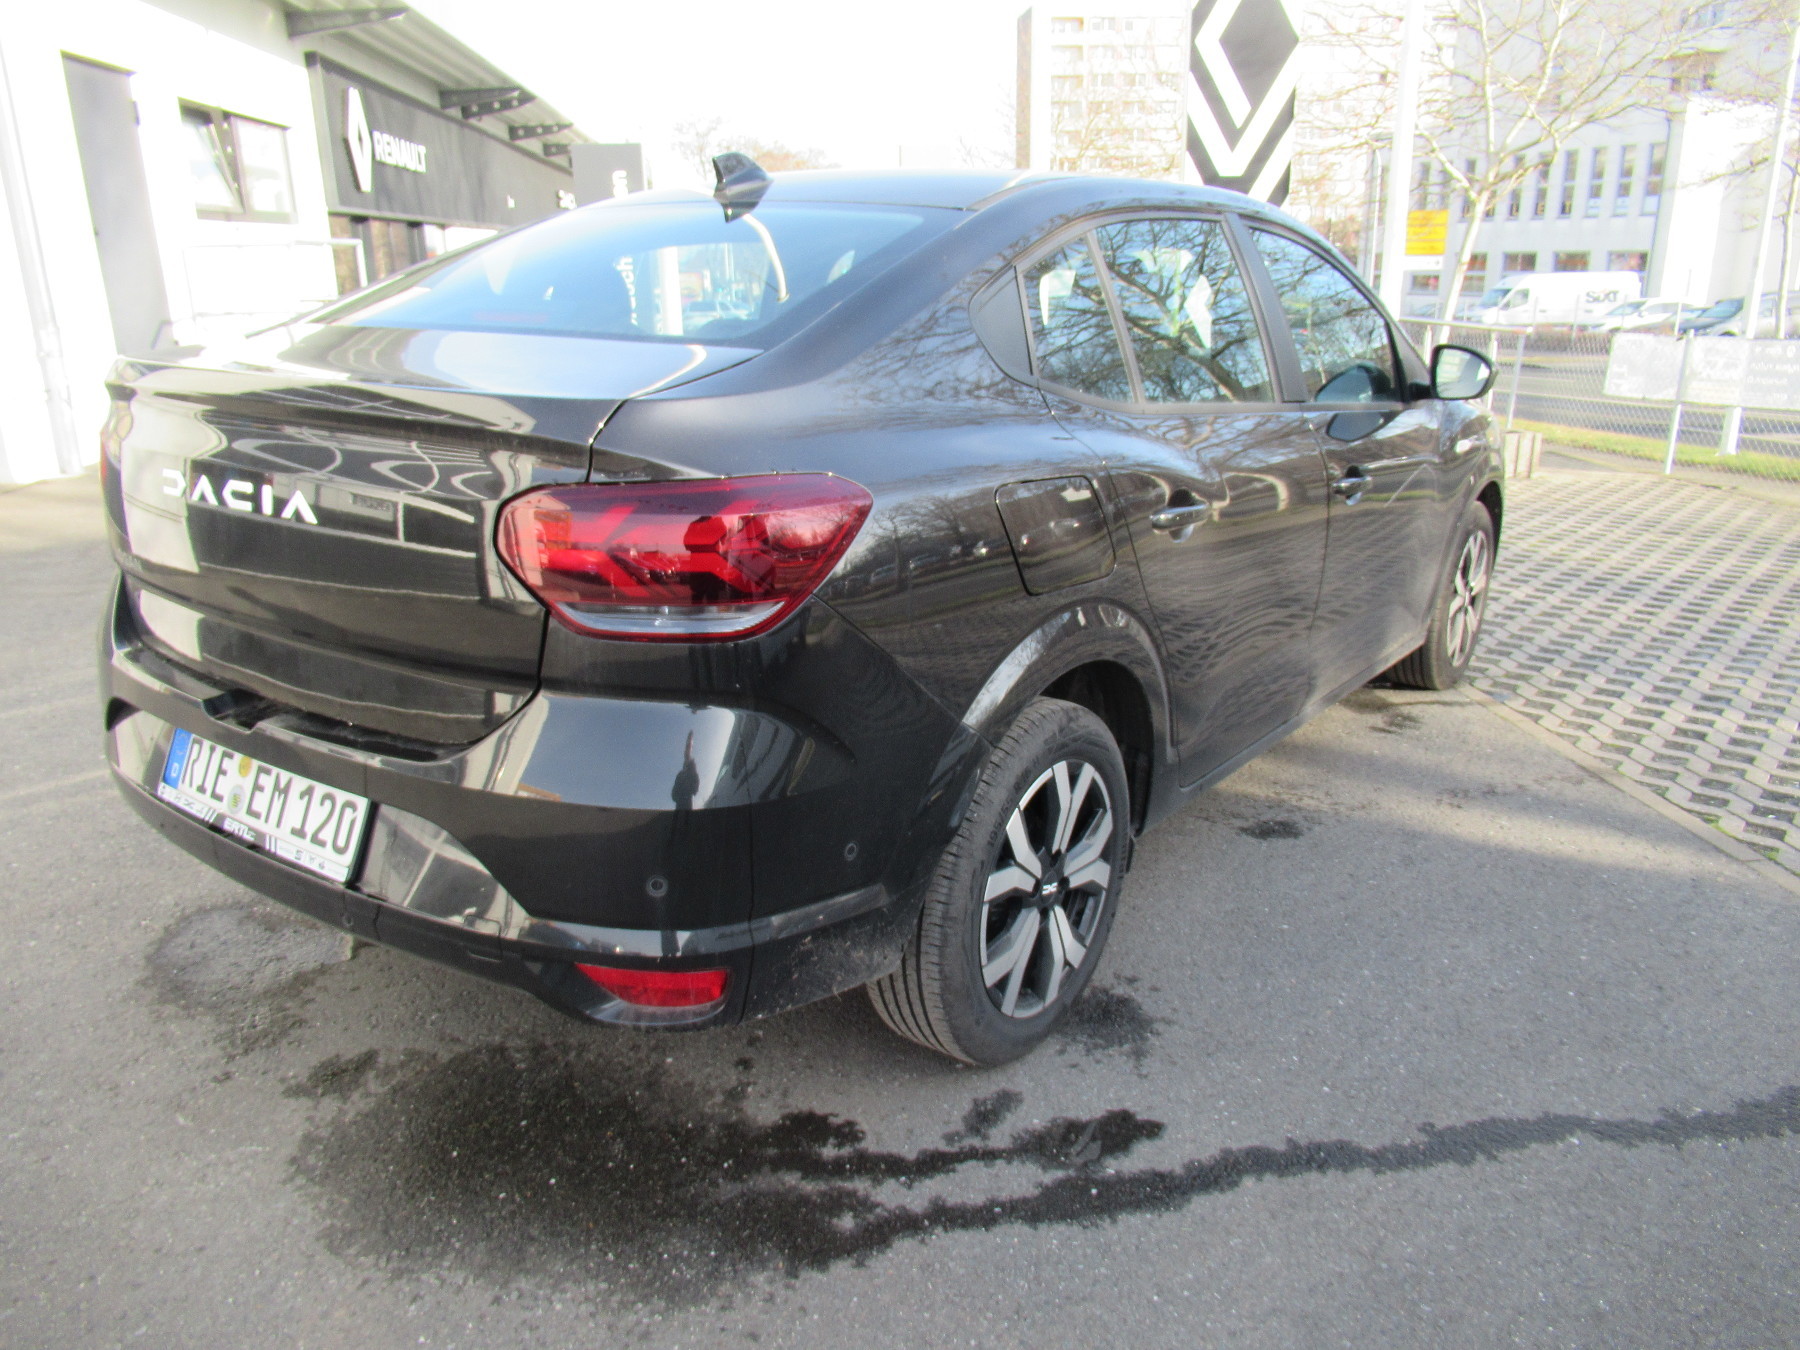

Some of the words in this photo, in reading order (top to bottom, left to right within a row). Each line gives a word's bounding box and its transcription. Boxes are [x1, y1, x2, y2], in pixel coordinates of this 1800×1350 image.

[372, 130, 427, 173] RENAULT
[161, 467, 318, 525] DACIA
[170, 762, 179, 778] D
[181, 737, 235, 803] RIE
